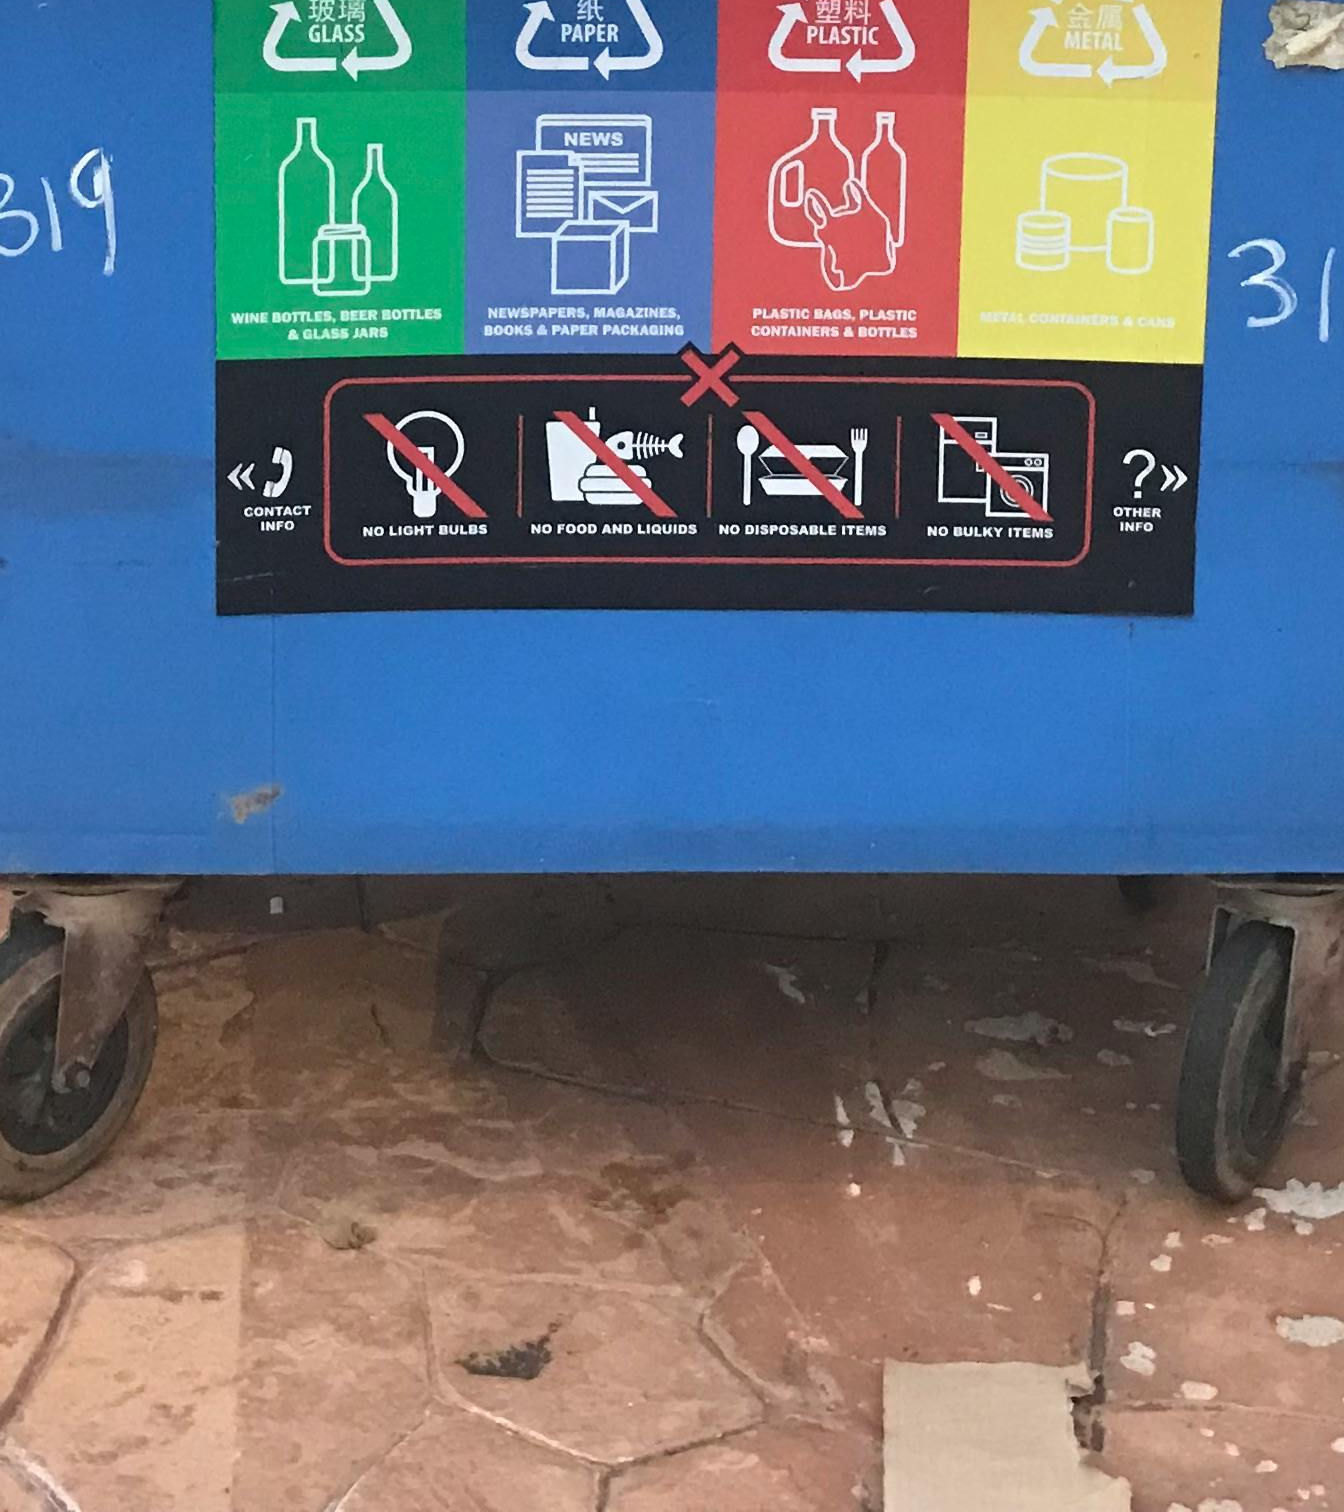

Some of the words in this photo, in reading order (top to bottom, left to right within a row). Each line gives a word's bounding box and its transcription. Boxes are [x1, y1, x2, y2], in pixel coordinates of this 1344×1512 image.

[1066, 2, 1123, 31] 金属
[308, 24, 366, 43] GLASS
[561, 23, 619, 43] PAPER
[807, 25, 879, 45] PLASTIC
[1064, 31, 1123, 50] METAL
[564, 132, 623, 147] NEWS
[231, 312, 268, 324] WINE
[272, 310, 336, 324] BOTTLES,
[340, 309, 378, 322] BEER
[382, 308, 442, 321] BOTTLES
[488, 307, 590, 320] NEWSPAPERS,
[594, 307, 680, 320] MAGAZINES,
[752, 308, 810, 320] PLASTIC
[814, 309, 855, 321] BAGS,
[860, 309, 917, 321] PLASTIC
[980, 311, 1024, 324] METAL
[1029, 313, 1118, 326] CONTAINERS
[1138, 316, 1175, 328] CANS
[288, 329, 299, 340] &
[303, 328, 349, 340] GLASS
[352, 327, 388, 339] JARS
[484, 325, 533, 336] BOOKS
[537, 325, 547, 336] &
[552, 325, 598, 336] PAPER
[603, 325, 684, 336] PACKAGING
[751, 326, 840, 337] CONTAINERS
[844, 327, 854, 338] &
[858, 327, 918, 338] BOTTLES
[244, 505, 311, 517] CONTACT
[1113, 507, 1161, 518] OTHER
[260, 520, 295, 532] INFO
[363, 526, 384, 537] NO
[389, 525, 434, 536] LIGHT
[438, 524, 488, 535] BULBS
[530, 524, 552, 534] NO
[557, 524, 598, 534] FOOD
[602, 524, 633, 534] AND
[637, 524, 697, 535] LIQUIDS
[719, 524, 740, 535] NO
[745, 524, 837, 535] DISPOSABLE
[842, 525, 886, 536] ITEMS
[927, 525, 949, 537] NO
[953, 526, 1003, 538] BULKY
[1008, 527, 1054, 538] ITEMS
[1119, 521, 1153, 532] INFO
